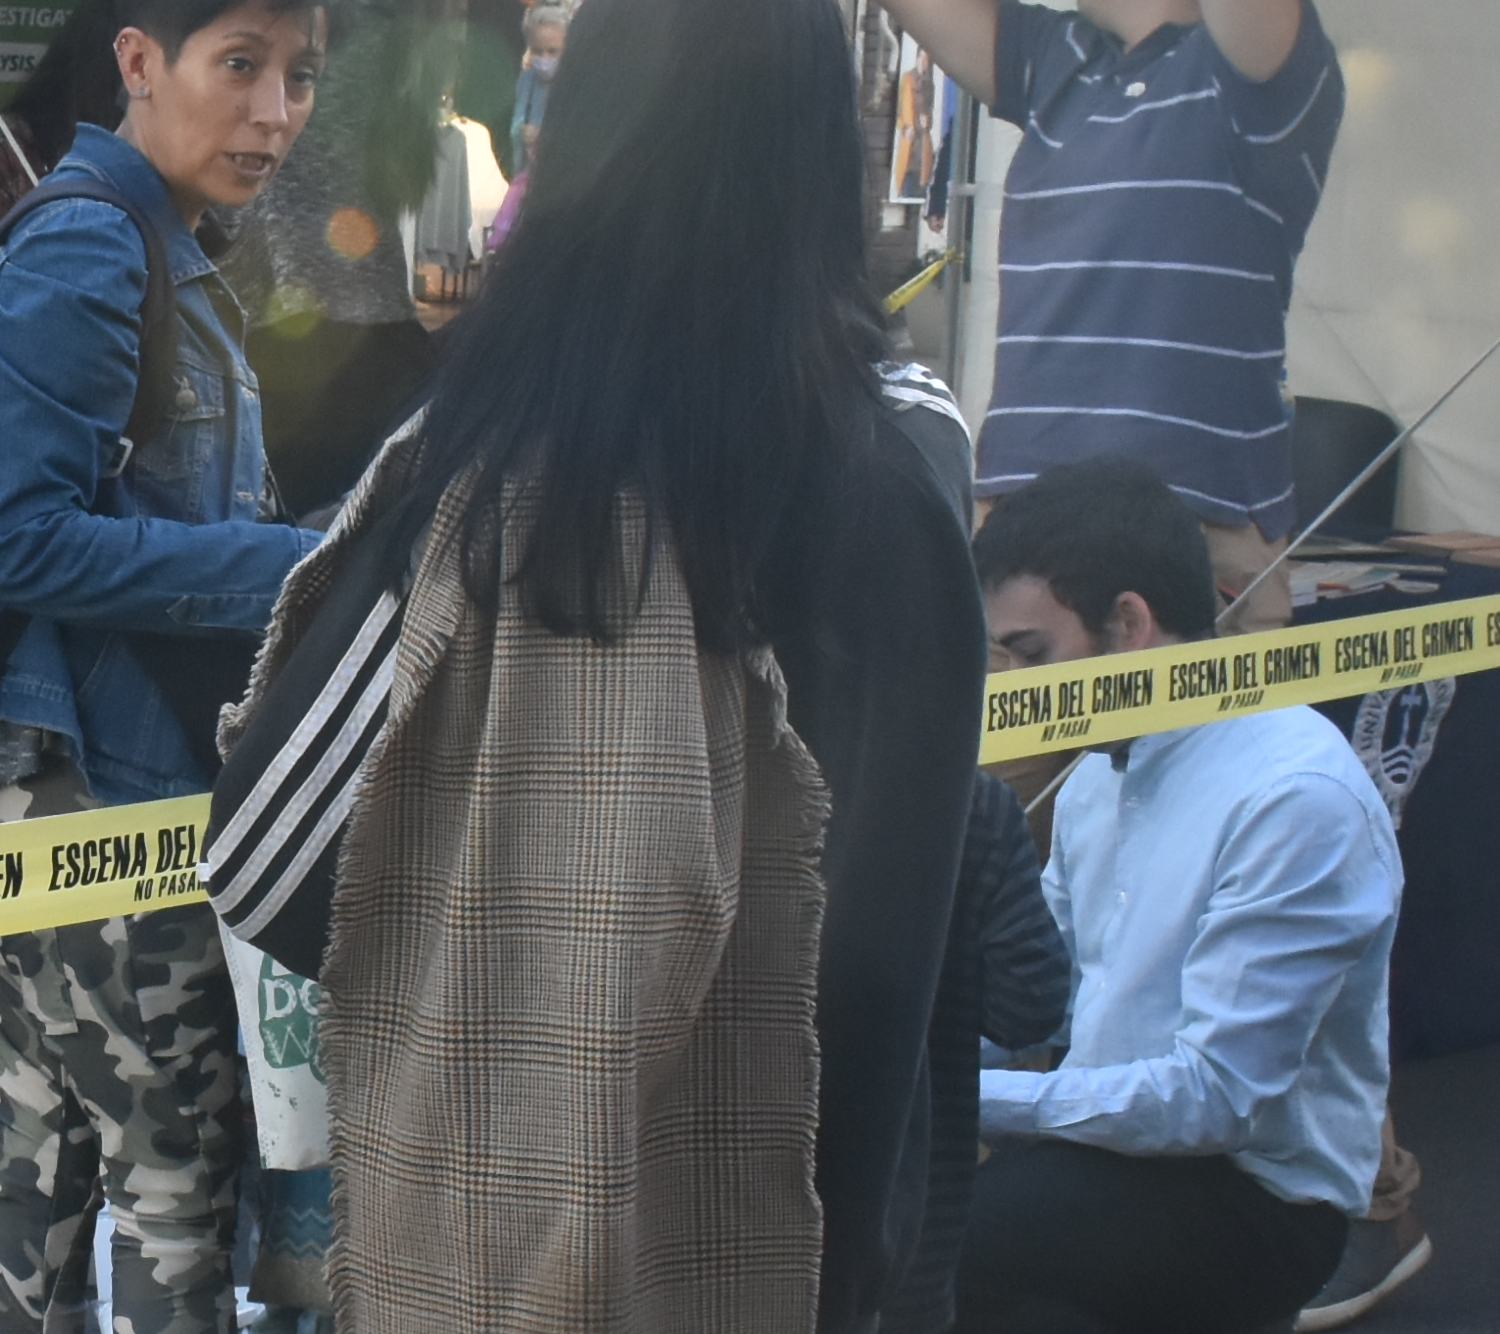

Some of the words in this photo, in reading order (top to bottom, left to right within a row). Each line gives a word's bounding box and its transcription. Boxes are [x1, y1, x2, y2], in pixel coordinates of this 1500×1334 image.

[1169, 657, 1228, 702] ESCENA
[1232, 651, 1259, 691] DEL
[1263, 641, 1321, 686] CRIMEN
[1335, 629, 1389, 674] ESCENA
[1393, 625, 1416, 663] DEL
[1421, 615, 1474, 657] CRIMEN
[987, 684, 1051, 733] ESCENA
[1057, 679, 1085, 720] DEL
[1091, 668, 1154, 714] CRIMEN
[1041, 725, 1055, 743] NO
[1057, 718, 1092, 738] PASAR
[48, 835, 147, 892] ESCENA
[155, 824, 196, 872] DEL
[133, 880, 151, 903] NO
